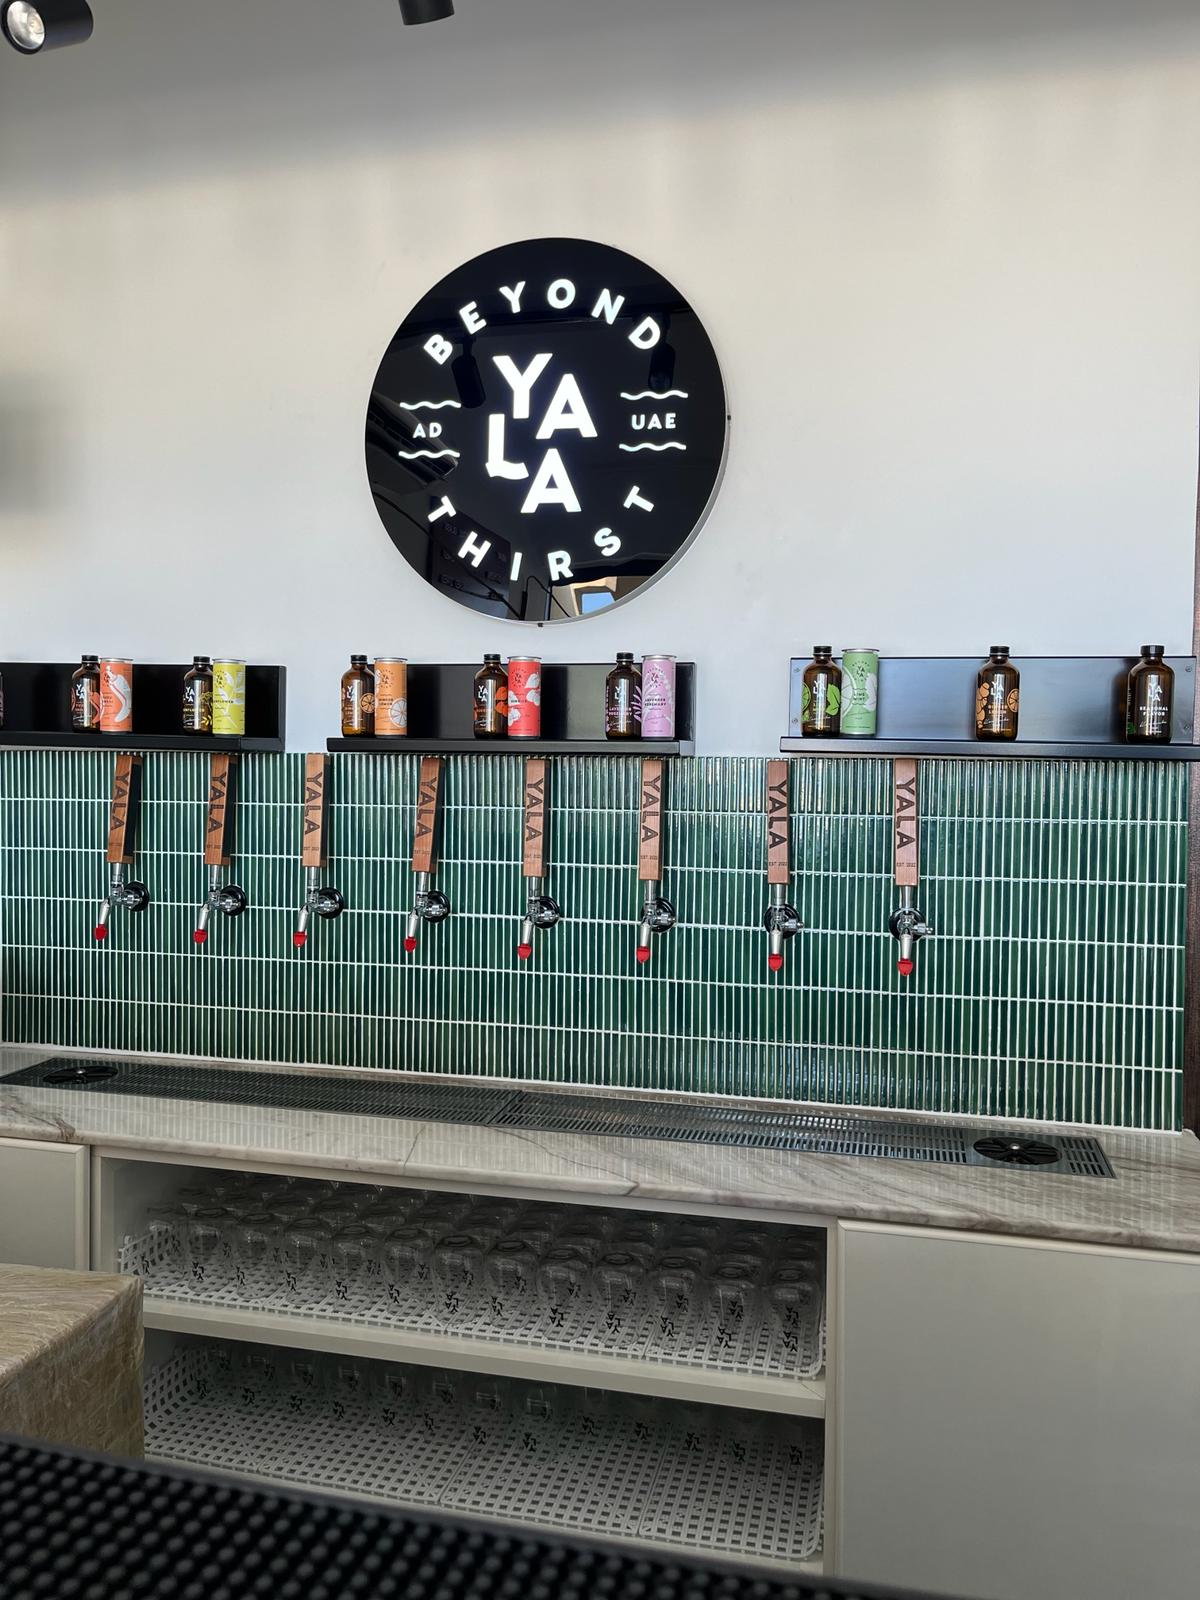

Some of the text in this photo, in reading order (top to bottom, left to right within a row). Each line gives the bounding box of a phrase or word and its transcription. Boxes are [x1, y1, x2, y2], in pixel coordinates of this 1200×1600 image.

[424, 278, 661, 365] BEYOND
[412, 422, 443, 438] AD
[631, 412, 677, 430] UAE
[427, 485, 655, 581] THIRST
[110, 772, 130, 831] YALA
[208, 772, 227, 833] YALA
[304, 772, 322, 835] YALA
[416, 777, 437, 838] YALA
[526, 778, 544, 842] YALA
[642, 775, 660, 842] YALA
[768, 780, 787, 849] YALA
[896, 777, 916, 849] YALA
